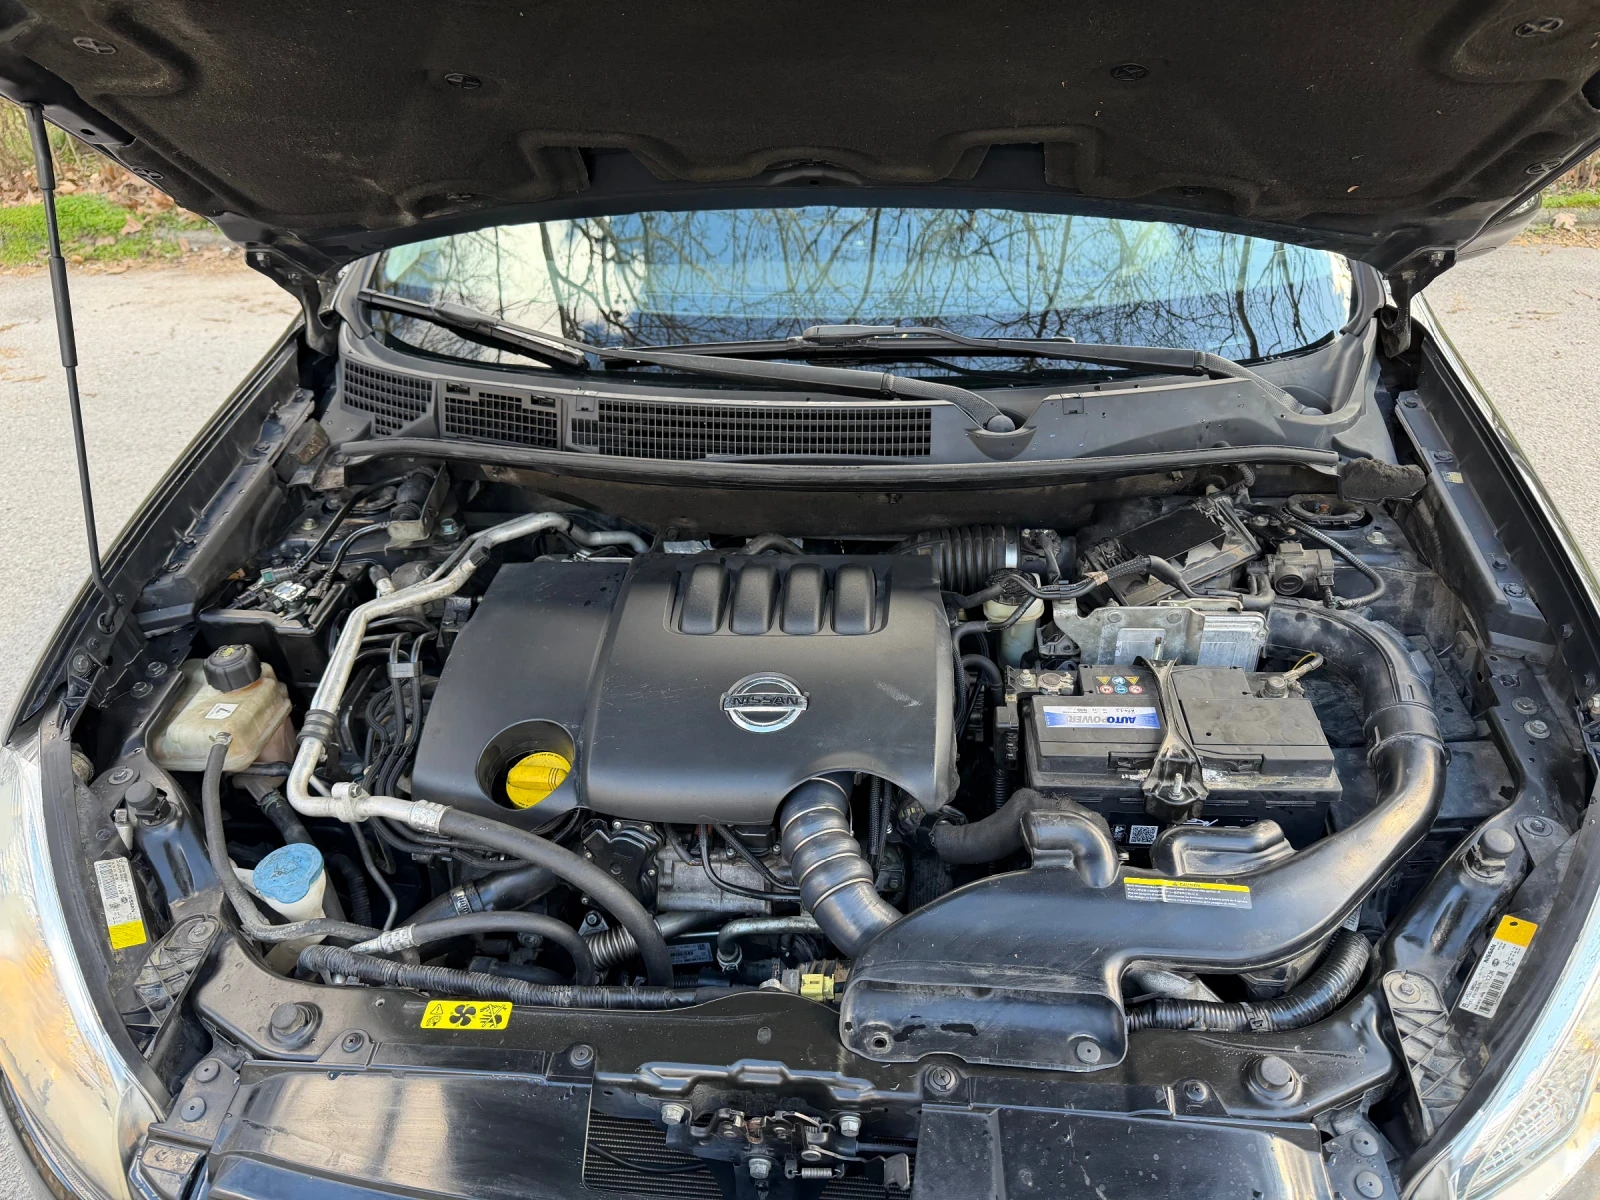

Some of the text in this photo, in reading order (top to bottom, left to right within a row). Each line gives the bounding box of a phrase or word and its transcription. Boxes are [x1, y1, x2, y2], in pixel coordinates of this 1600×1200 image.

[733, 696, 799, 706] NISSAN
[1068, 715, 1136, 724] AUTOPOWER
[1483, 943, 1497, 963] NISSAN
